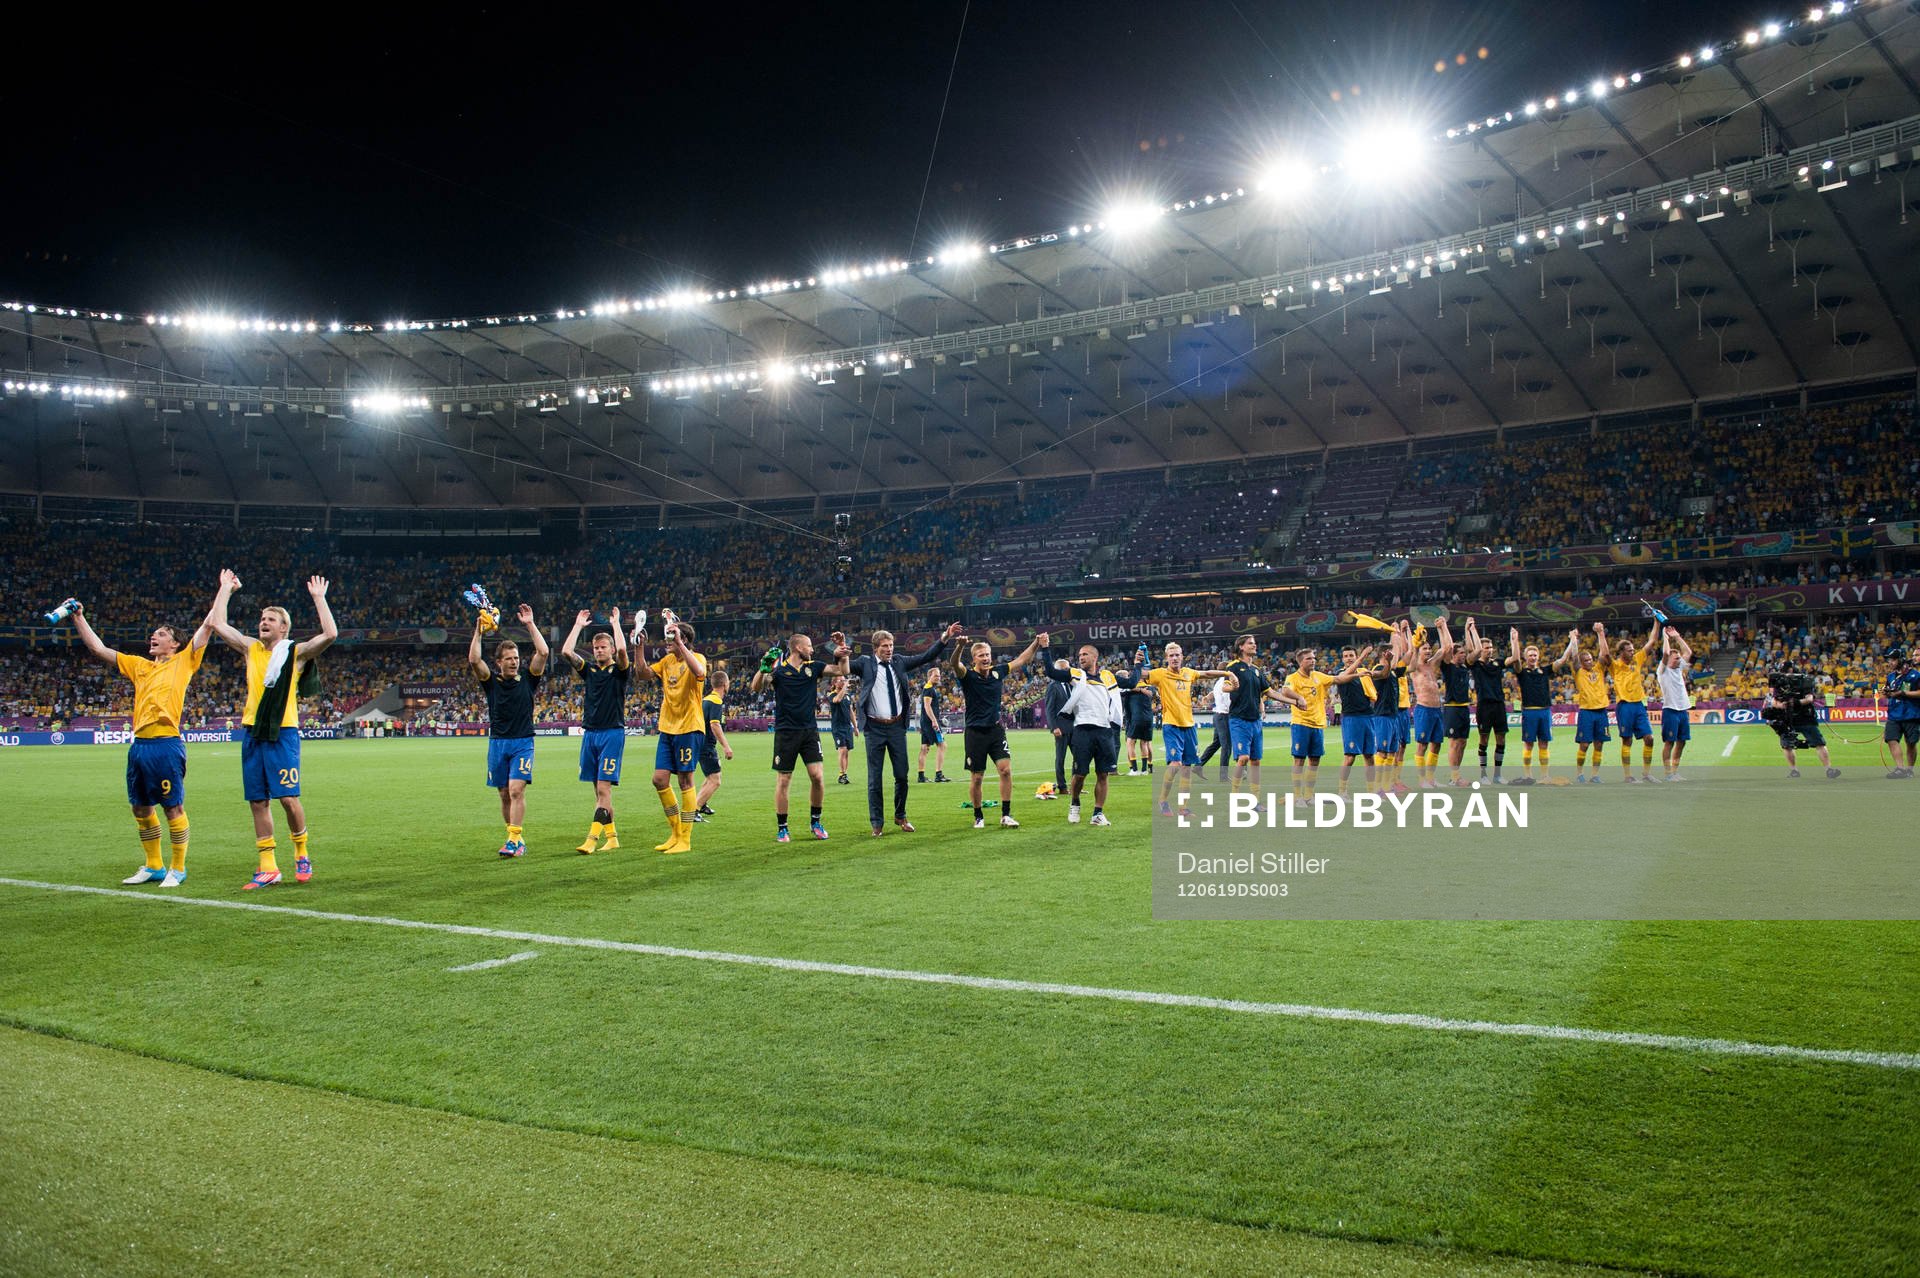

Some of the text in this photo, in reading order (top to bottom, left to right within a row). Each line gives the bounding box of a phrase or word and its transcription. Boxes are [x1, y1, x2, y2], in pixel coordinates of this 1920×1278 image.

[1828, 583, 1908, 603] KYIV
[1089, 621, 1213, 639] UEFA EURO 2012
[403, 687, 421, 695] UEFA
[187, 730, 232, 742] DIVERSITÉ
[680, 748, 692, 762] 13
[518, 757, 531, 771] 14
[602, 758, 616, 772] 15
[279, 767, 298, 785] 20
[161, 779, 171, 795] 9
